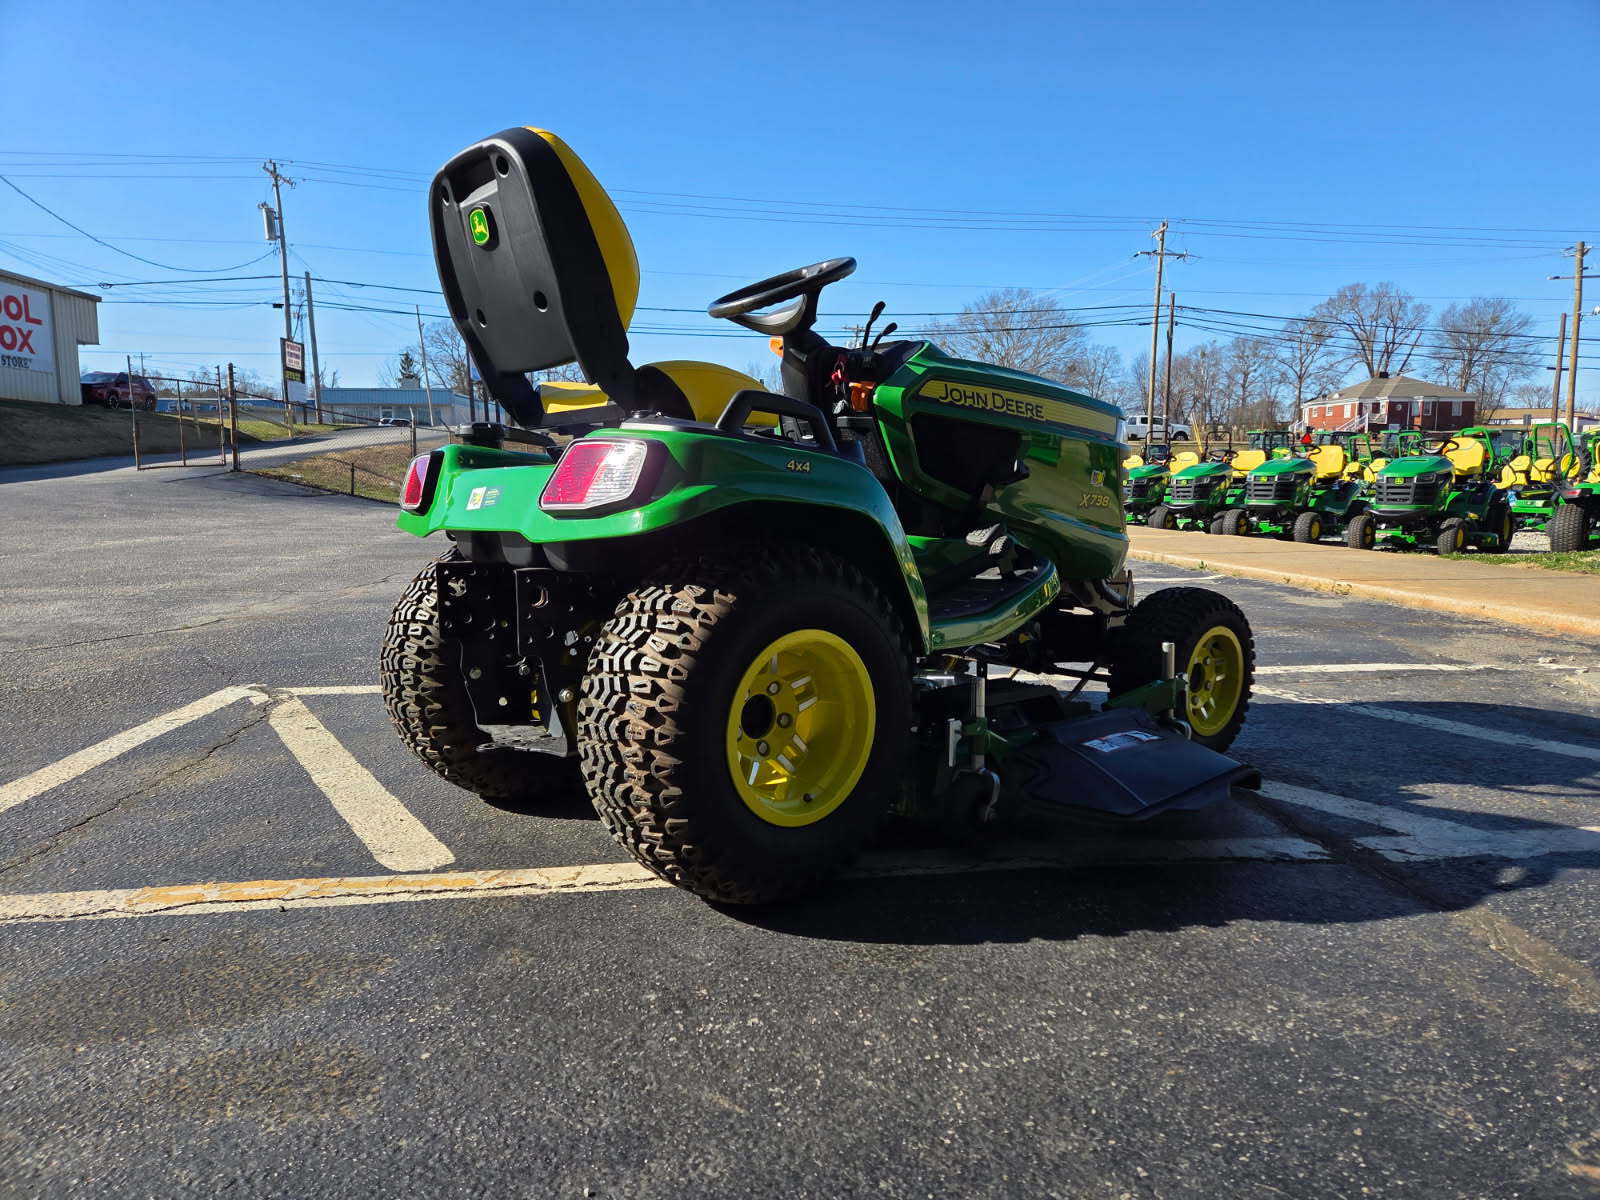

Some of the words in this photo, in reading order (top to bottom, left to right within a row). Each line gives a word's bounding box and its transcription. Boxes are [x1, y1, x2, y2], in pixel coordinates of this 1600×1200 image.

[0, 294, 43, 326] OL
[939, 383, 989, 408] JOHN
[991, 391, 1045, 420] DEERE
[786, 459, 811, 473] 4x4
[1079, 493, 1110, 508] X738
